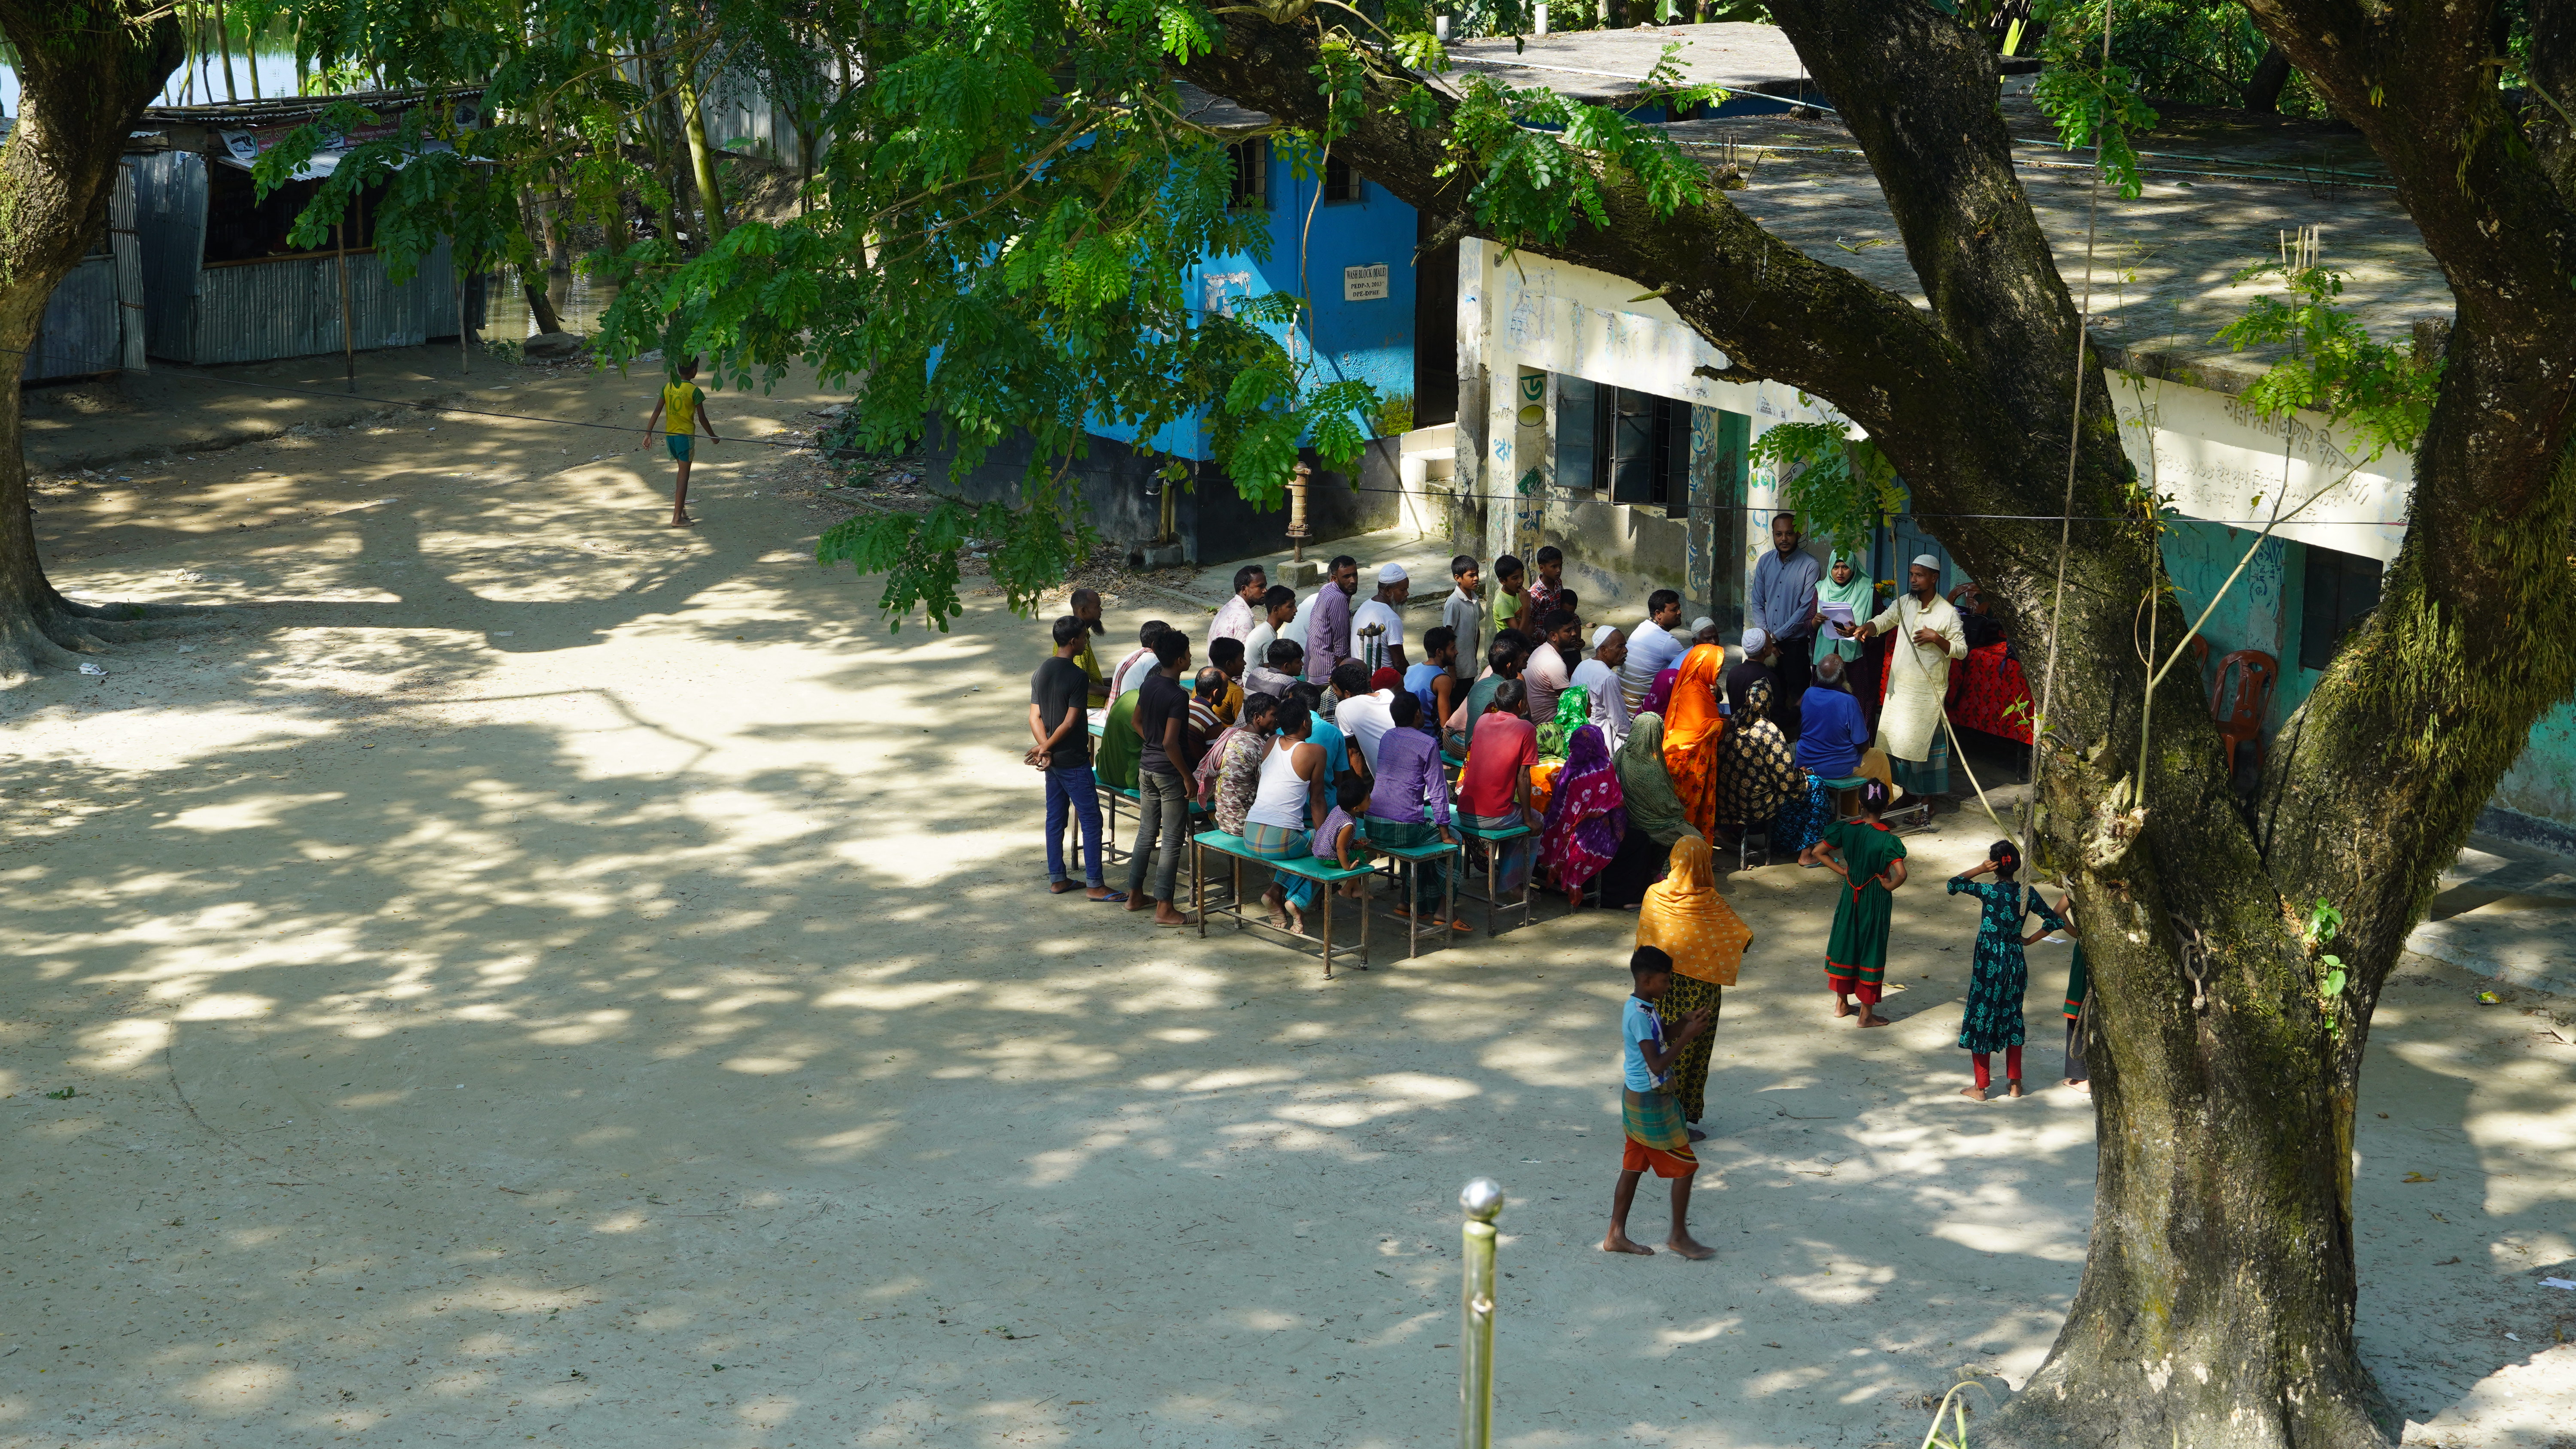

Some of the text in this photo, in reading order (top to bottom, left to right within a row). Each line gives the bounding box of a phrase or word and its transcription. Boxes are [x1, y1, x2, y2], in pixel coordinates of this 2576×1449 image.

[1347, 267, 1386, 279] WASH BLOCK (MALE)
